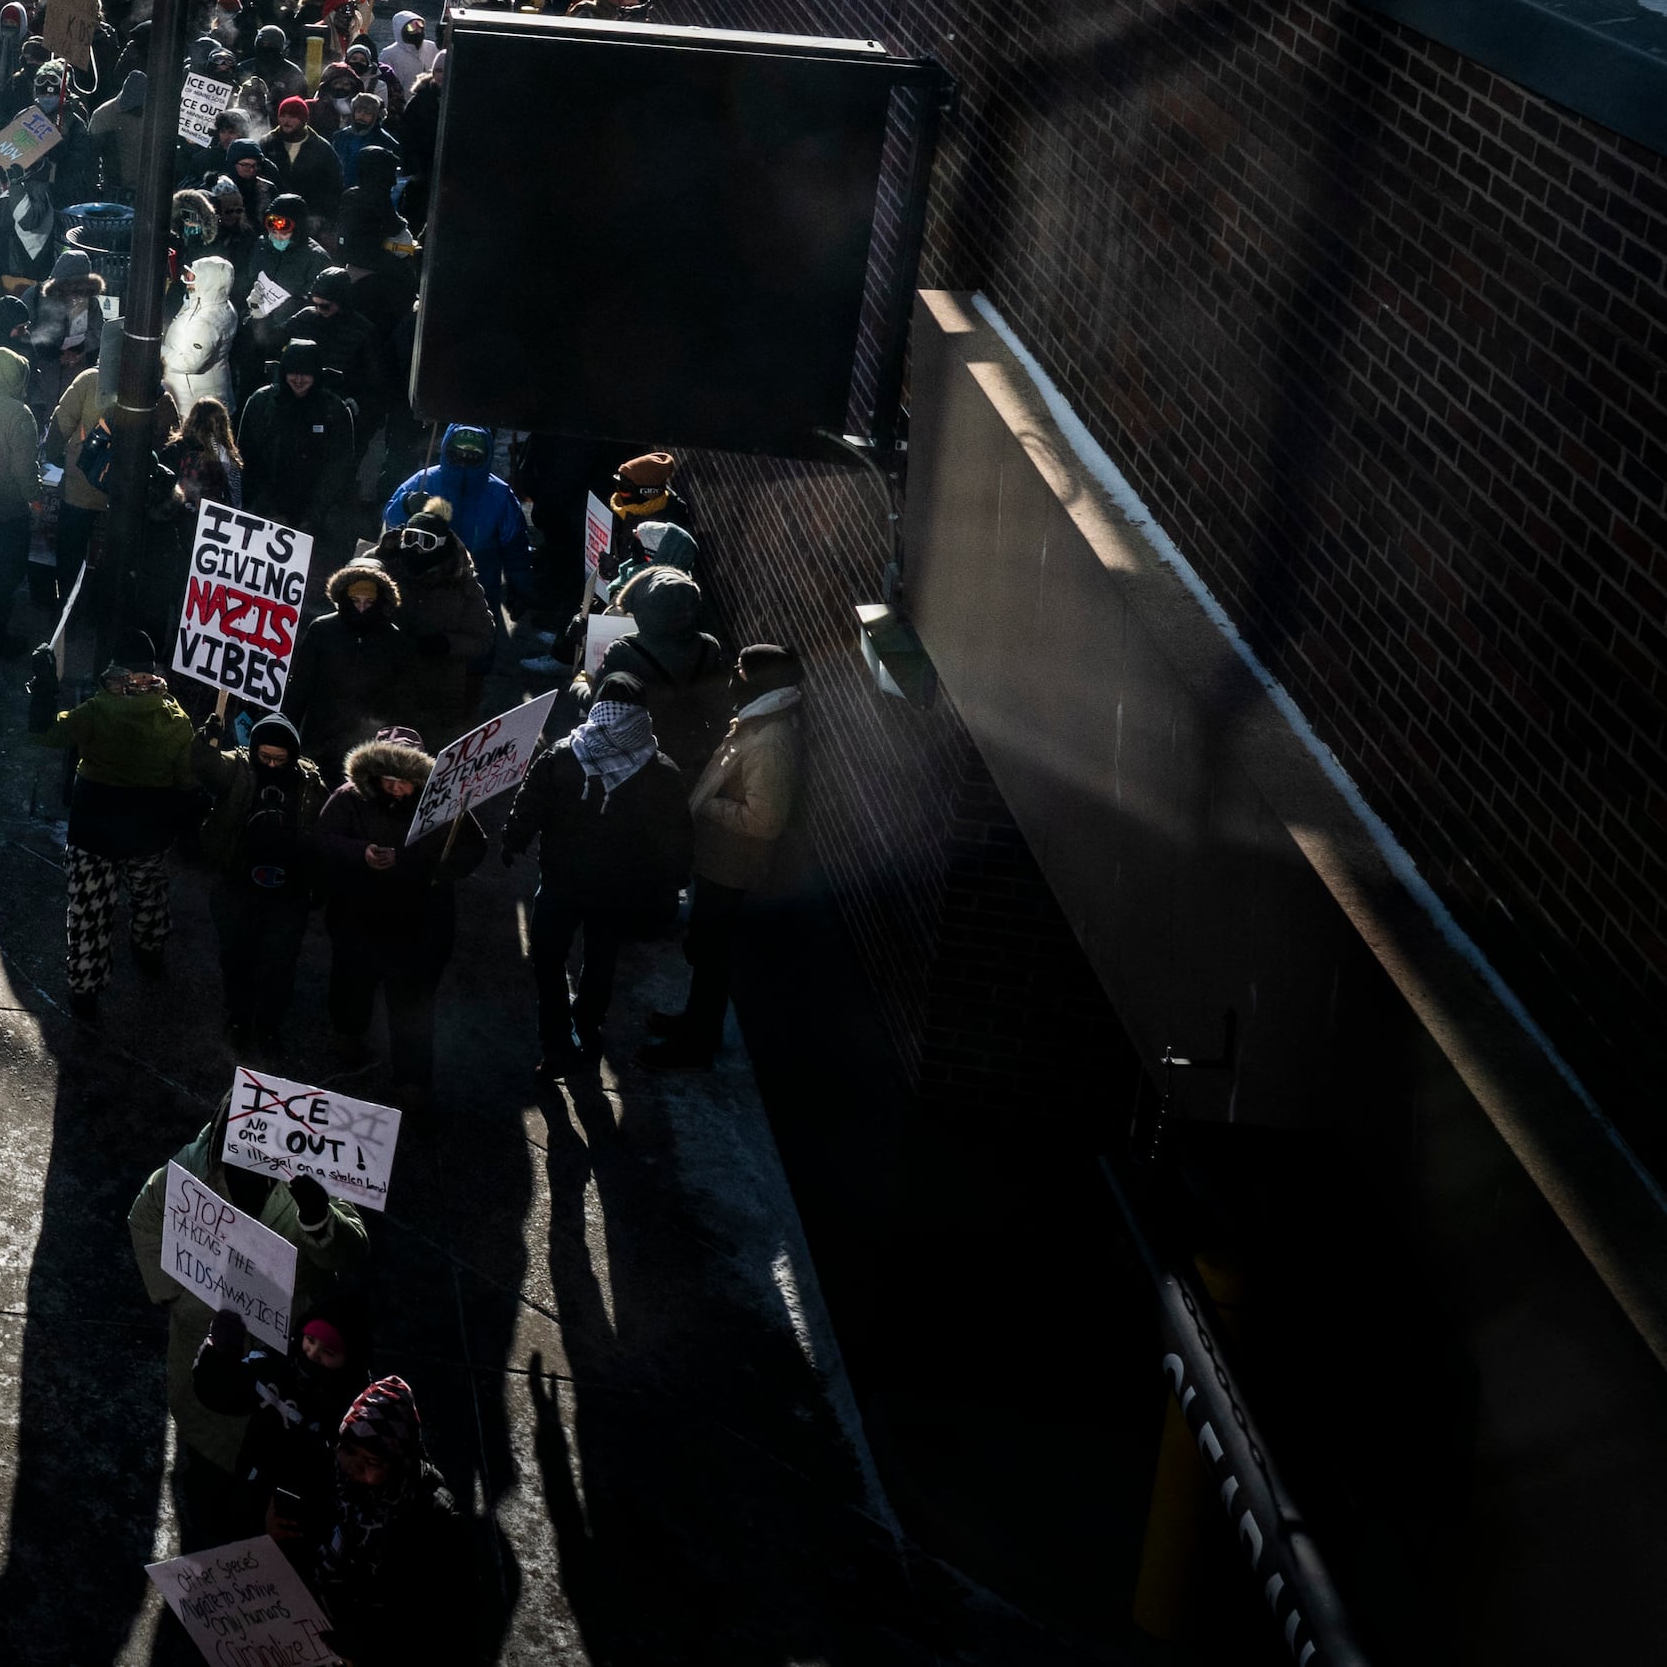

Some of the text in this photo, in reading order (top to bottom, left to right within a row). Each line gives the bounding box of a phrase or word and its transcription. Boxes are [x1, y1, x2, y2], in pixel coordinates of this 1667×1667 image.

[202, 504, 297, 565] IT'S
[196, 542, 305, 606] GIVING
[185, 575, 300, 659] NAZIS
[179, 627, 288, 709] VIBES
